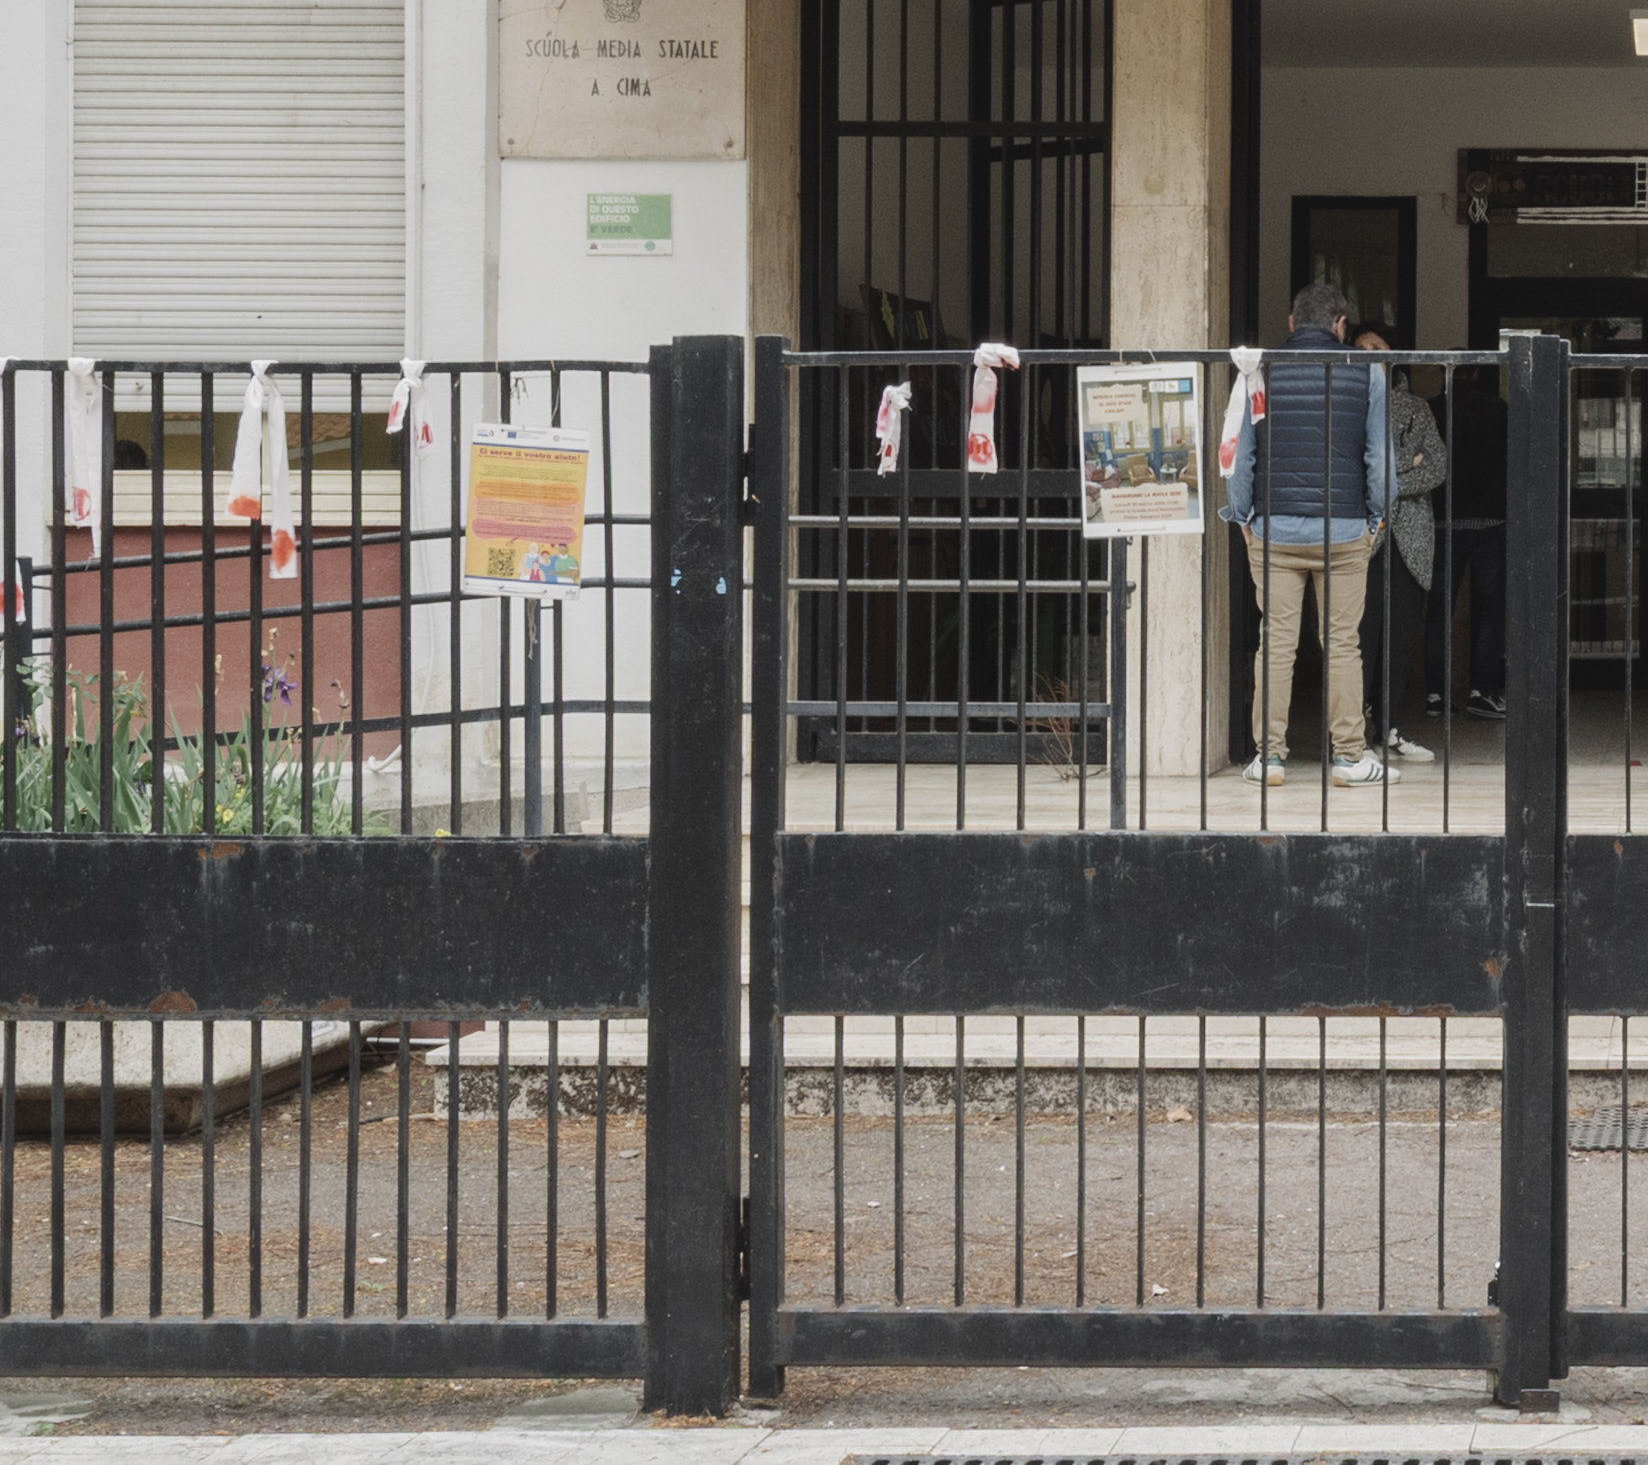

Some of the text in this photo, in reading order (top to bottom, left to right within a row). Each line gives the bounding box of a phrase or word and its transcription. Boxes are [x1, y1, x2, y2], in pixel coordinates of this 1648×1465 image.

[525, 39, 719, 59] SCUOLA MEDIA STATALE
[616, 78, 652, 97] CIMA
[589, 196, 636, 204] L'ENERGIA
[589, 205, 640, 214] DI QUESTO
[589, 214, 631, 223] EDIFICIO
[479, 447, 488, 455] Ci
